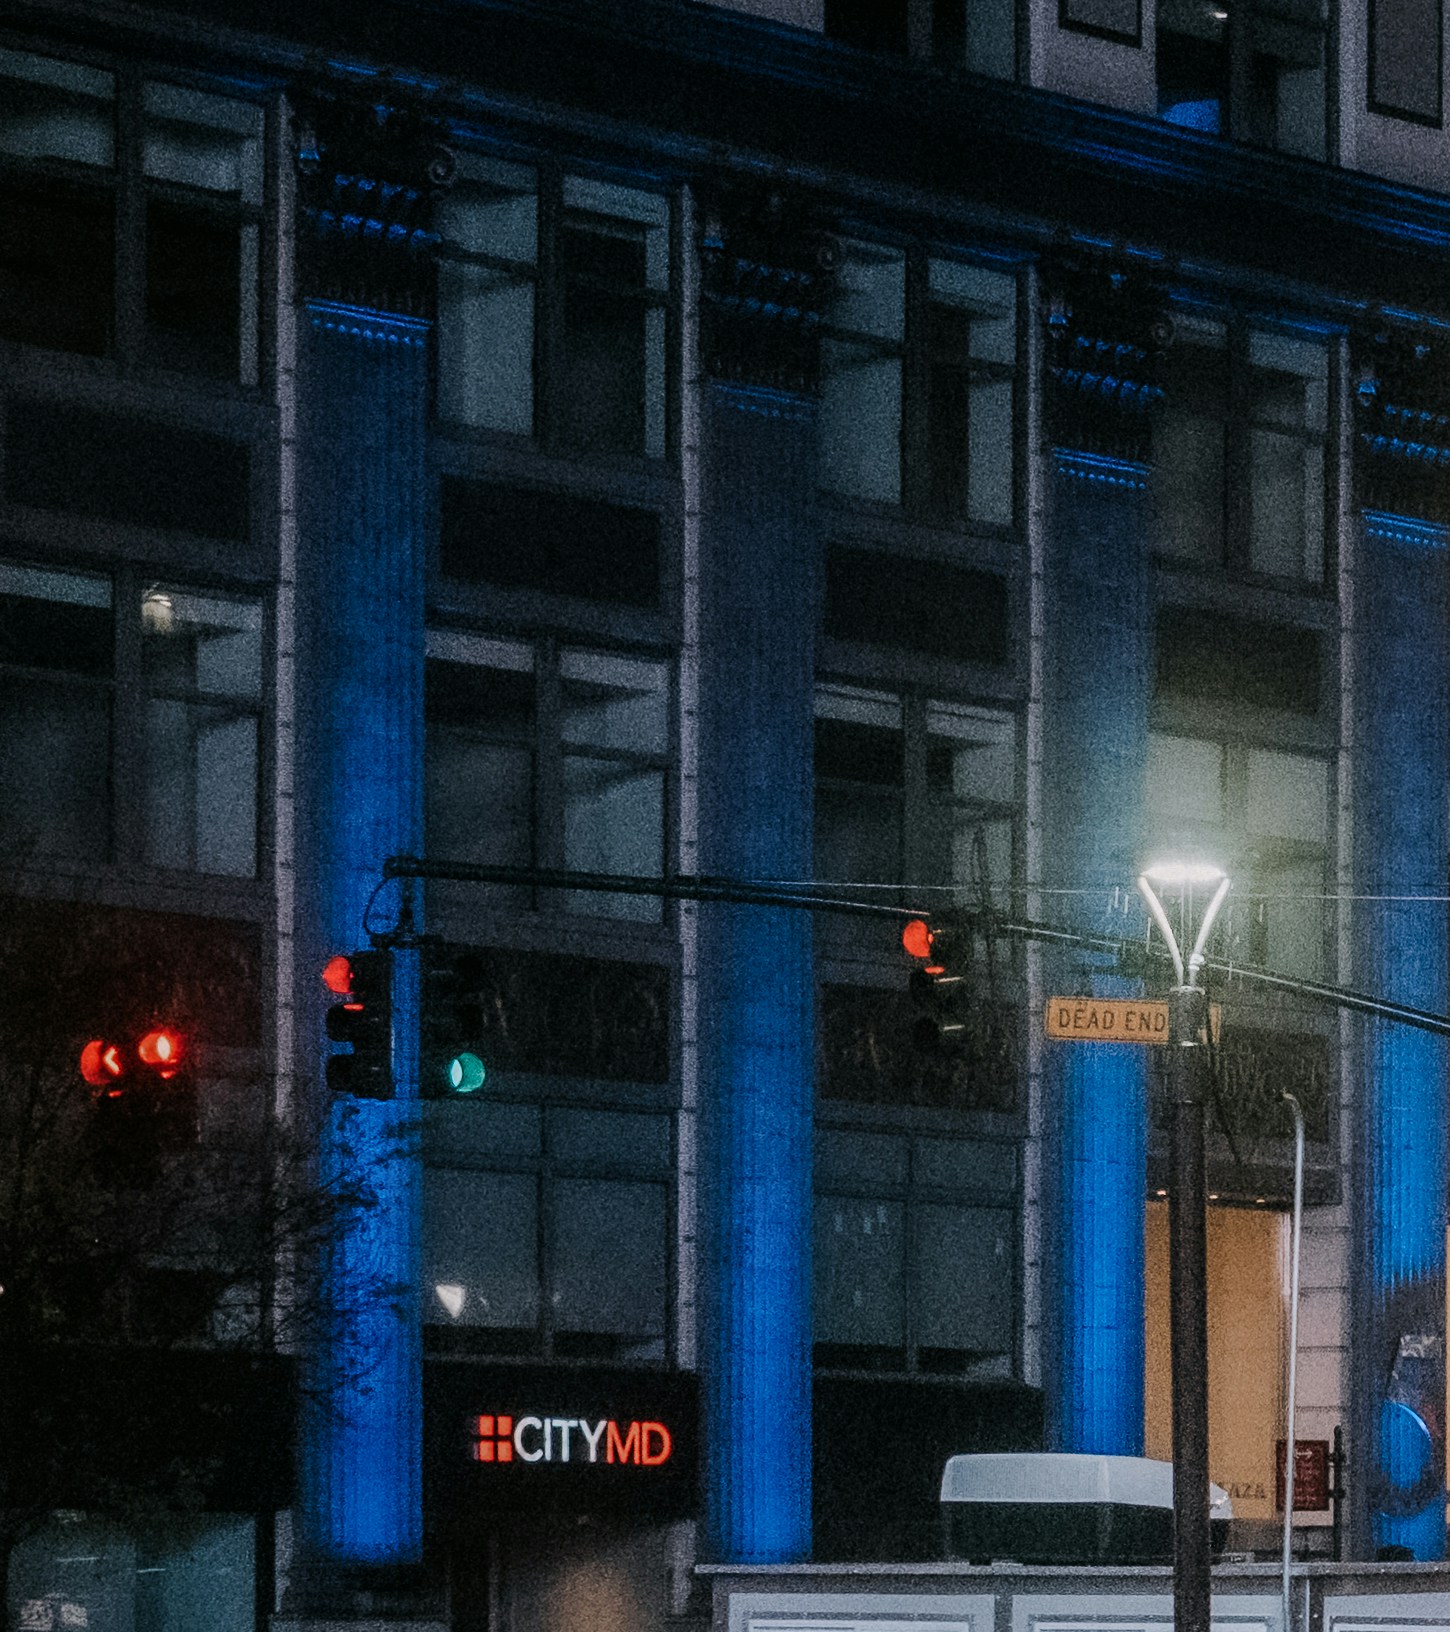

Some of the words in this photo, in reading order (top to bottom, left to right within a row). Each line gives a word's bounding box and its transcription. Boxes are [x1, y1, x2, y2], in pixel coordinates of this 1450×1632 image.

[1057, 1006, 1115, 1031] DEAD
[1124, 1010, 1167, 1033] END
[513, 1415, 673, 1467] CITYMD
